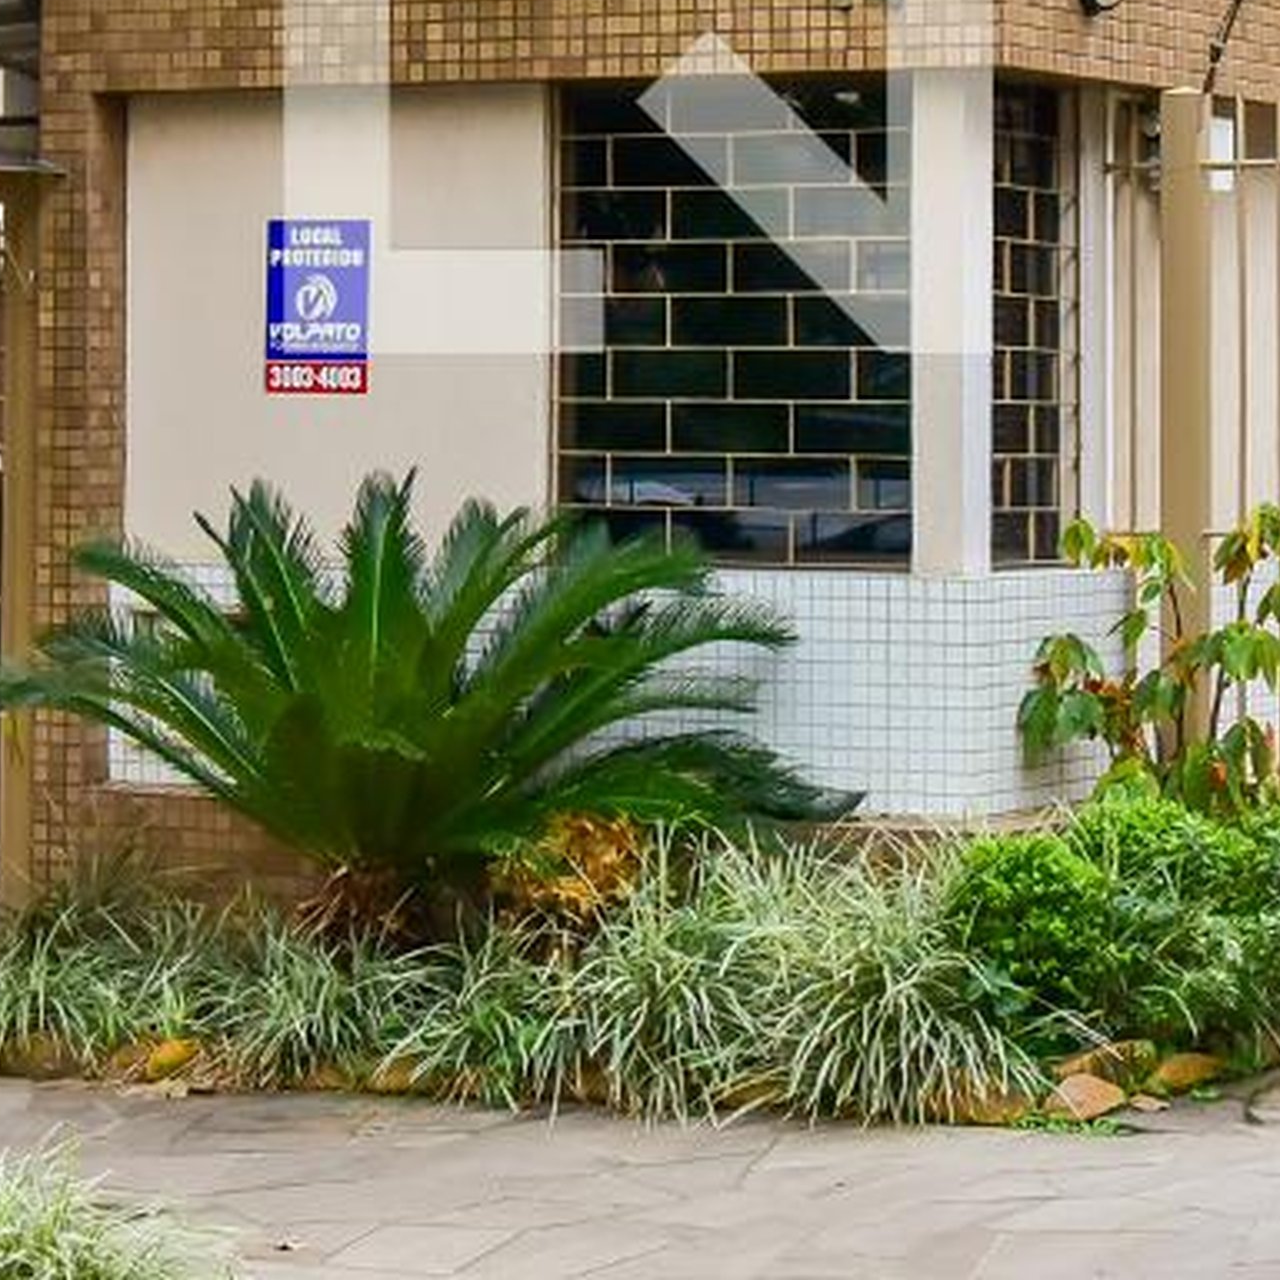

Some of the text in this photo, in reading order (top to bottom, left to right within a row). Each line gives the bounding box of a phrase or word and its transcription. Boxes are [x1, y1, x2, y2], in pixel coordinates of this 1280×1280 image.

[290, 227, 343, 245] LOCAL
[270, 249, 364, 267] PROTEGIDO
[270, 322, 361, 342] VOLPATO
